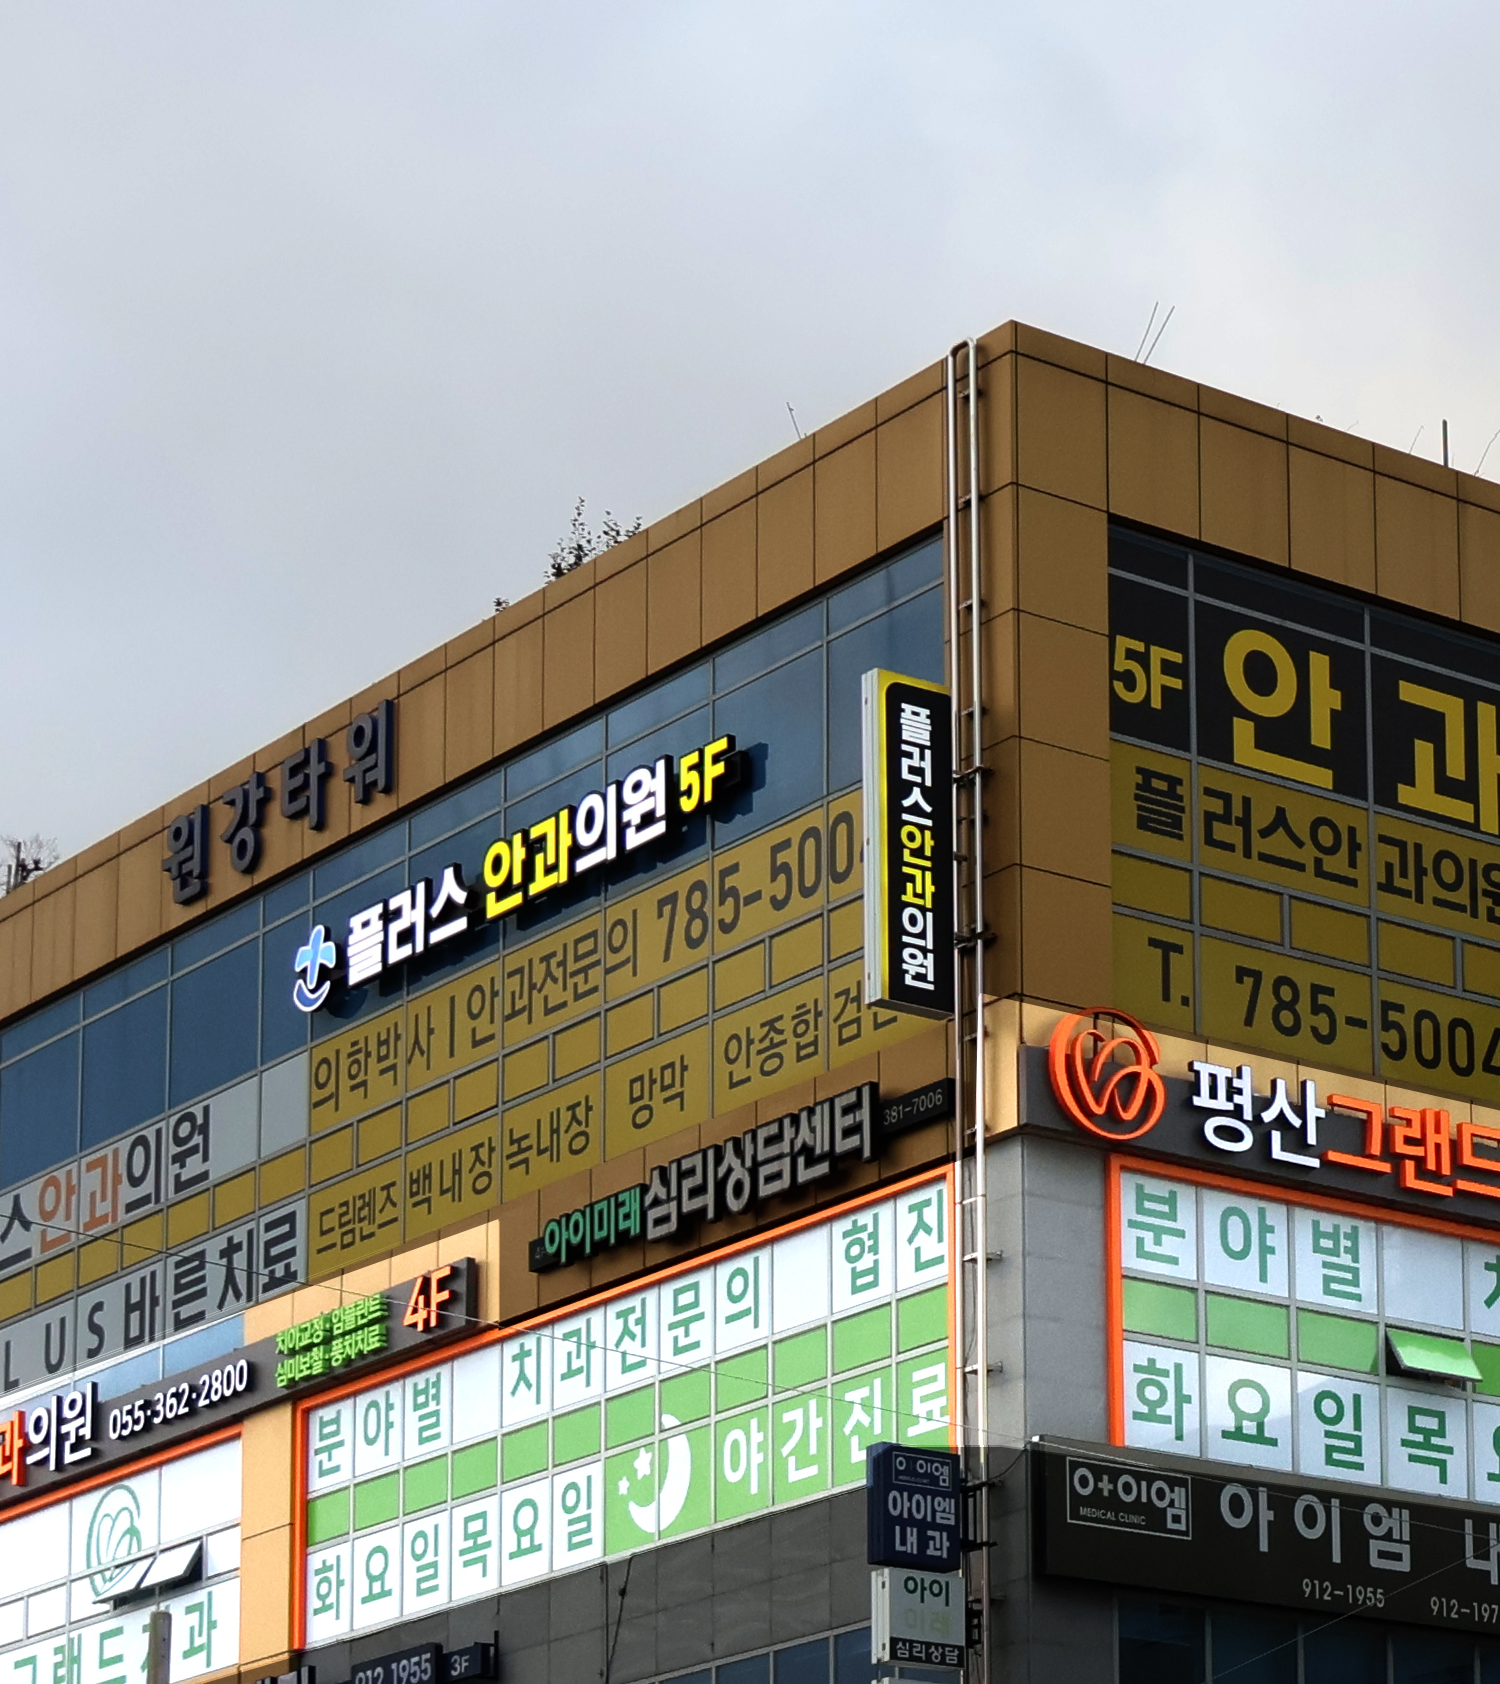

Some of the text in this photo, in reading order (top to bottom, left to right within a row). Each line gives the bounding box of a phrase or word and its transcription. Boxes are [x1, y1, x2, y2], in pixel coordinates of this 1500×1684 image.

[1112, 635, 1184, 710] 5F
[163, 699, 394, 906] 원강타워
[898, 702, 937, 991] 플러스안과의원
[346, 735, 730, 988] 플러스 안과의원 5F
[313, 907, 638, 1111] 의학박사 안과전문의
[316, 1055, 688, 1254] 드림렌즈 백내장 녹내장 망막
[543, 1081, 943, 1265] 아이미래 심리상담센터 381-7006
[125, 1203, 300, 1343] 바른치료
[1126, 1184, 1364, 1303] 분야별
[402, 1265, 452, 1330] 4F
[314, 1371, 442, 1479] 분야별
[511, 1255, 760, 1404] 치과전문의
[722, 1362, 948, 1495] 야간진료
[888, 1490, 955, 1525] 아이엠
[895, 1526, 949, 1559] 내과
[1079, 1506, 1147, 1526] MEDICAL CLINIC
[1220, 1483, 1411, 1573] 아이엠
[904, 1575, 949, 1607] 아이
[1302, 1578, 1385, 1608] 912-1955
[450, 1654, 470, 1676] 3F
[896, 1641, 959, 1664] 심리상담
